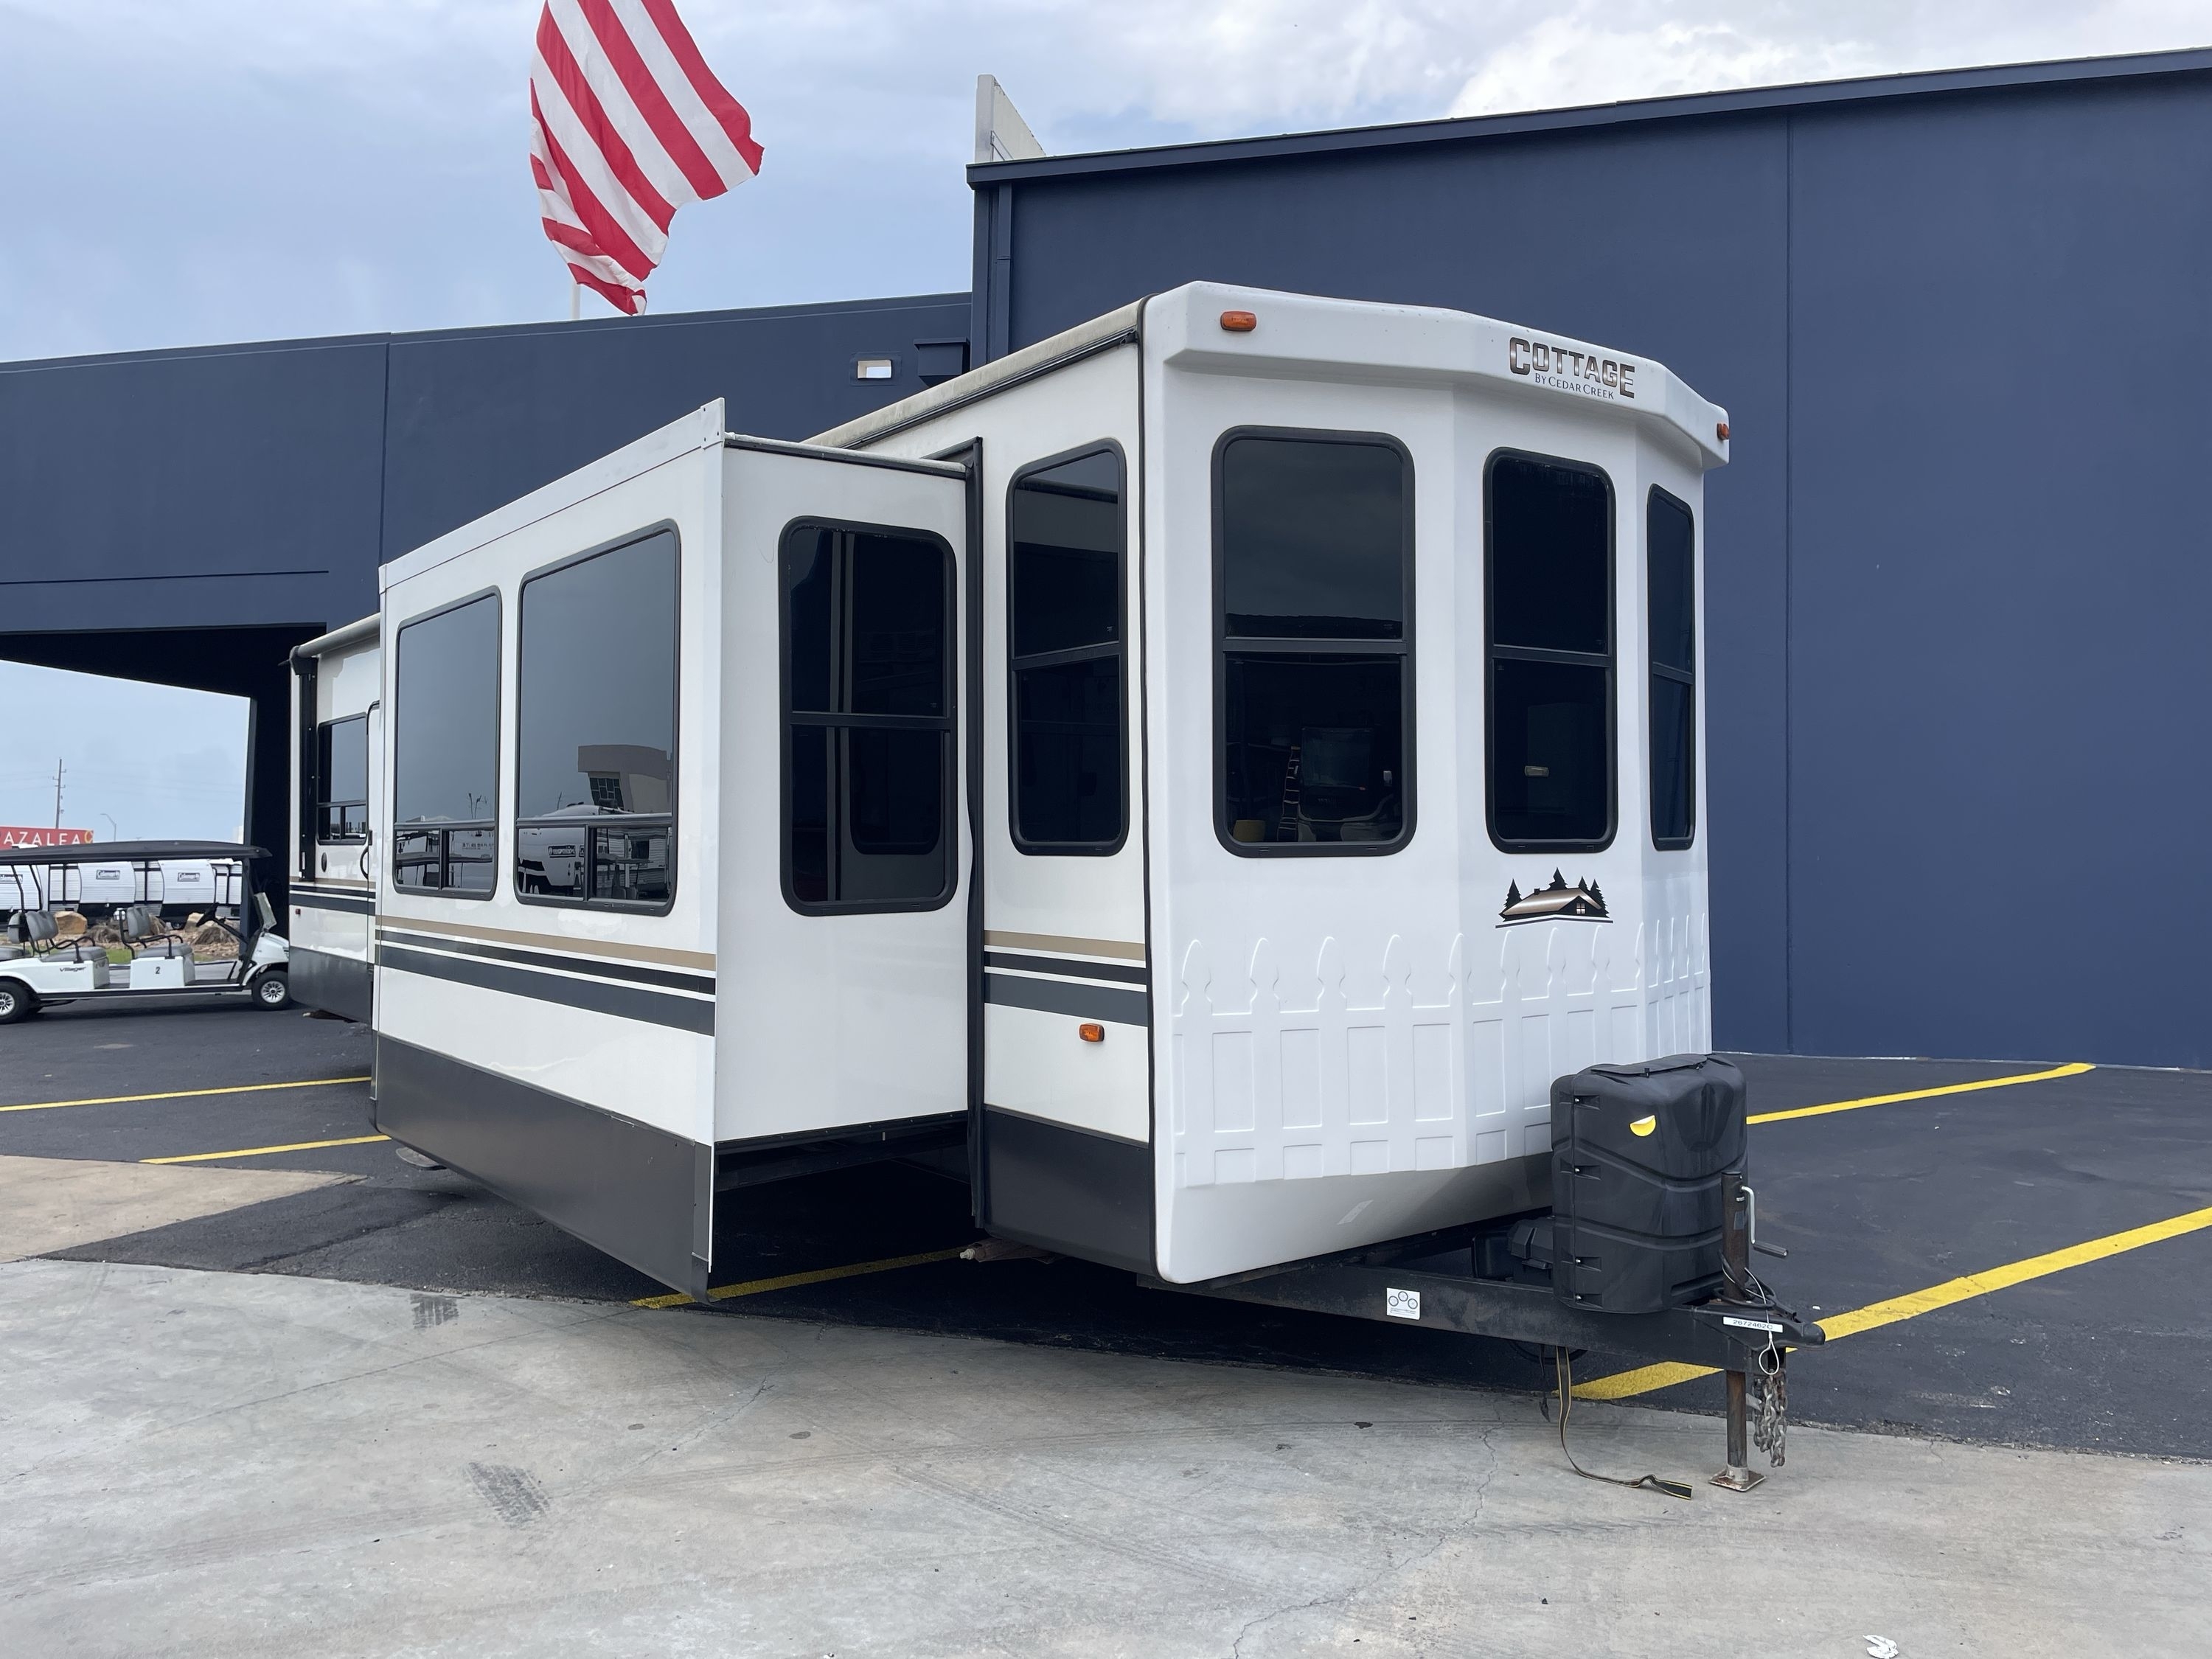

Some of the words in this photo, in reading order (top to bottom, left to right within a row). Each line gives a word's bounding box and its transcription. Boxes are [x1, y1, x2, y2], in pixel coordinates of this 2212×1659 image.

[1509, 337, 1635, 399] COTTAGE
[1535, 373, 1546, 384] BY
[1548, 376, 1582, 393] CEDAR
[1583, 384, 1614, 400] CREEK
[3, 831, 80, 846] AZALEA
